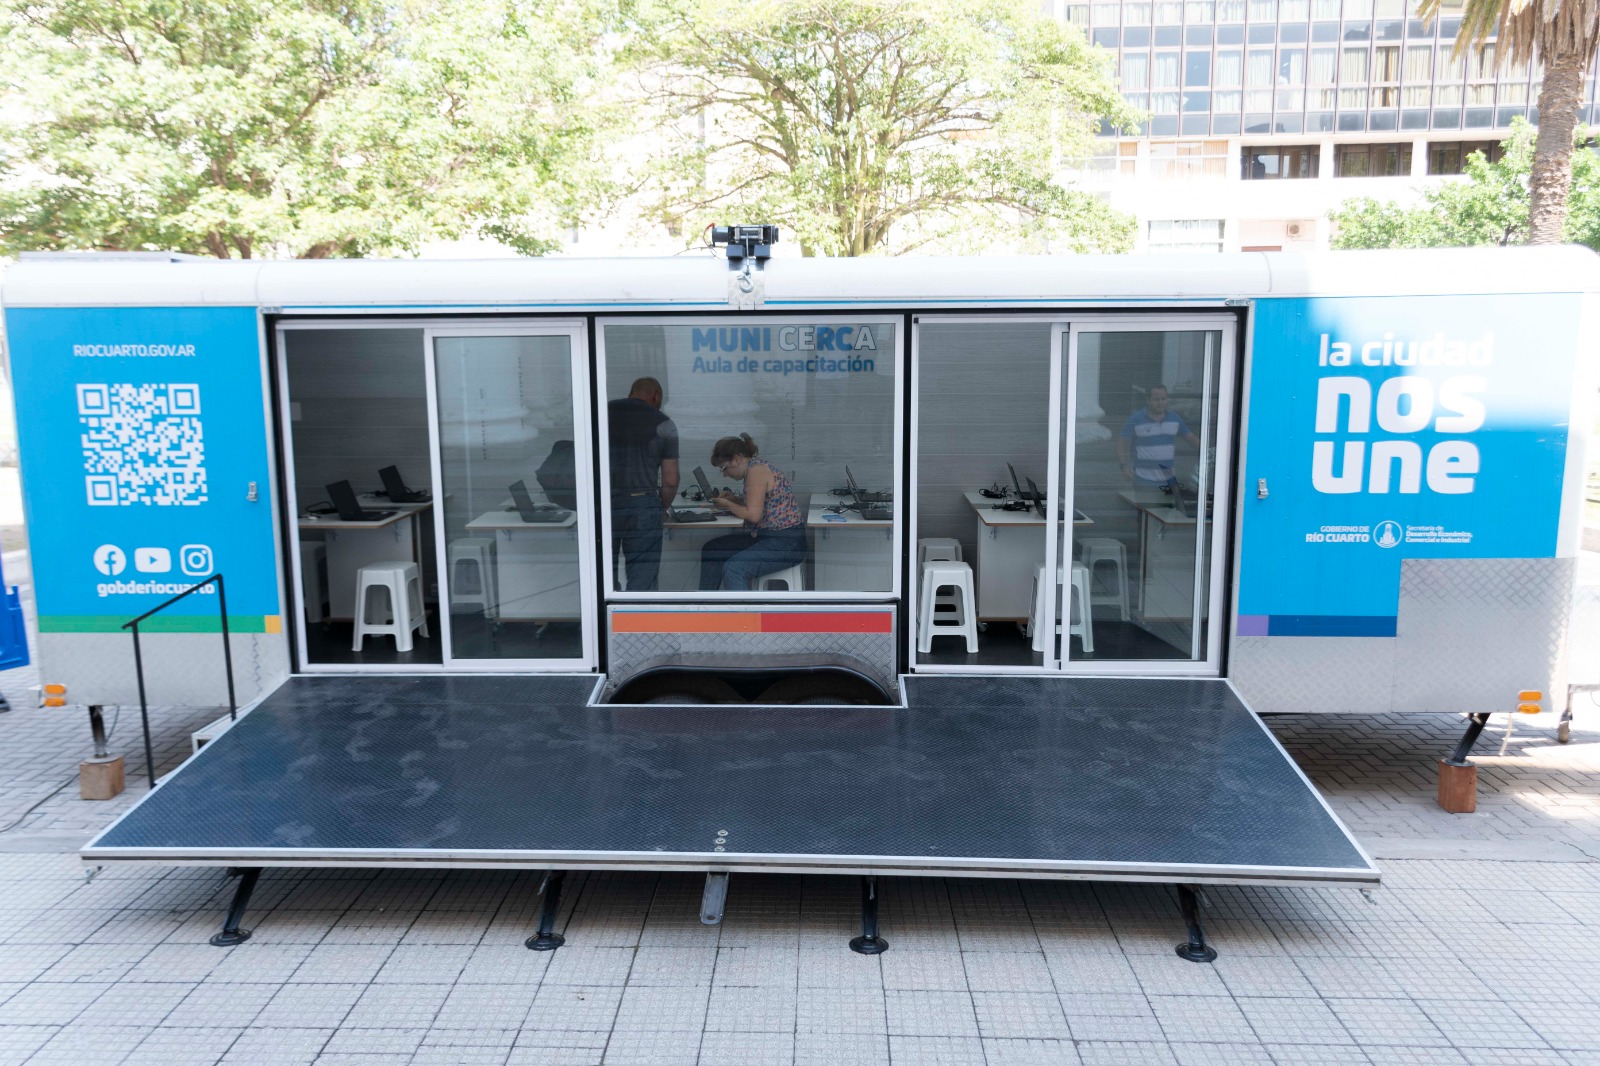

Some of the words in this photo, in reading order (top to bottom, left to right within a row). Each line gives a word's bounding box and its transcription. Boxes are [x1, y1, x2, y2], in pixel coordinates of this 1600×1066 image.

[73, 344, 196, 357] RIOCUARTO.GOV.AR
[691, 327, 771, 352] MUNI
[778, 325, 877, 351] CERCA
[1318, 333, 1353, 367] la
[1361, 331, 1494, 367] ciudad
[691, 356, 733, 373] Aula
[736, 356, 759, 373] de
[762, 354, 875, 377] capacitación
[1315, 375, 1487, 434] nos
[1312, 440, 1480, 494] une
[1305, 532, 1325, 543] RÍO
[1325, 533, 1370, 543] CUARTO
[1320, 525, 1357, 533] GOBIERNO
[1358, 525, 1370, 533] DE
